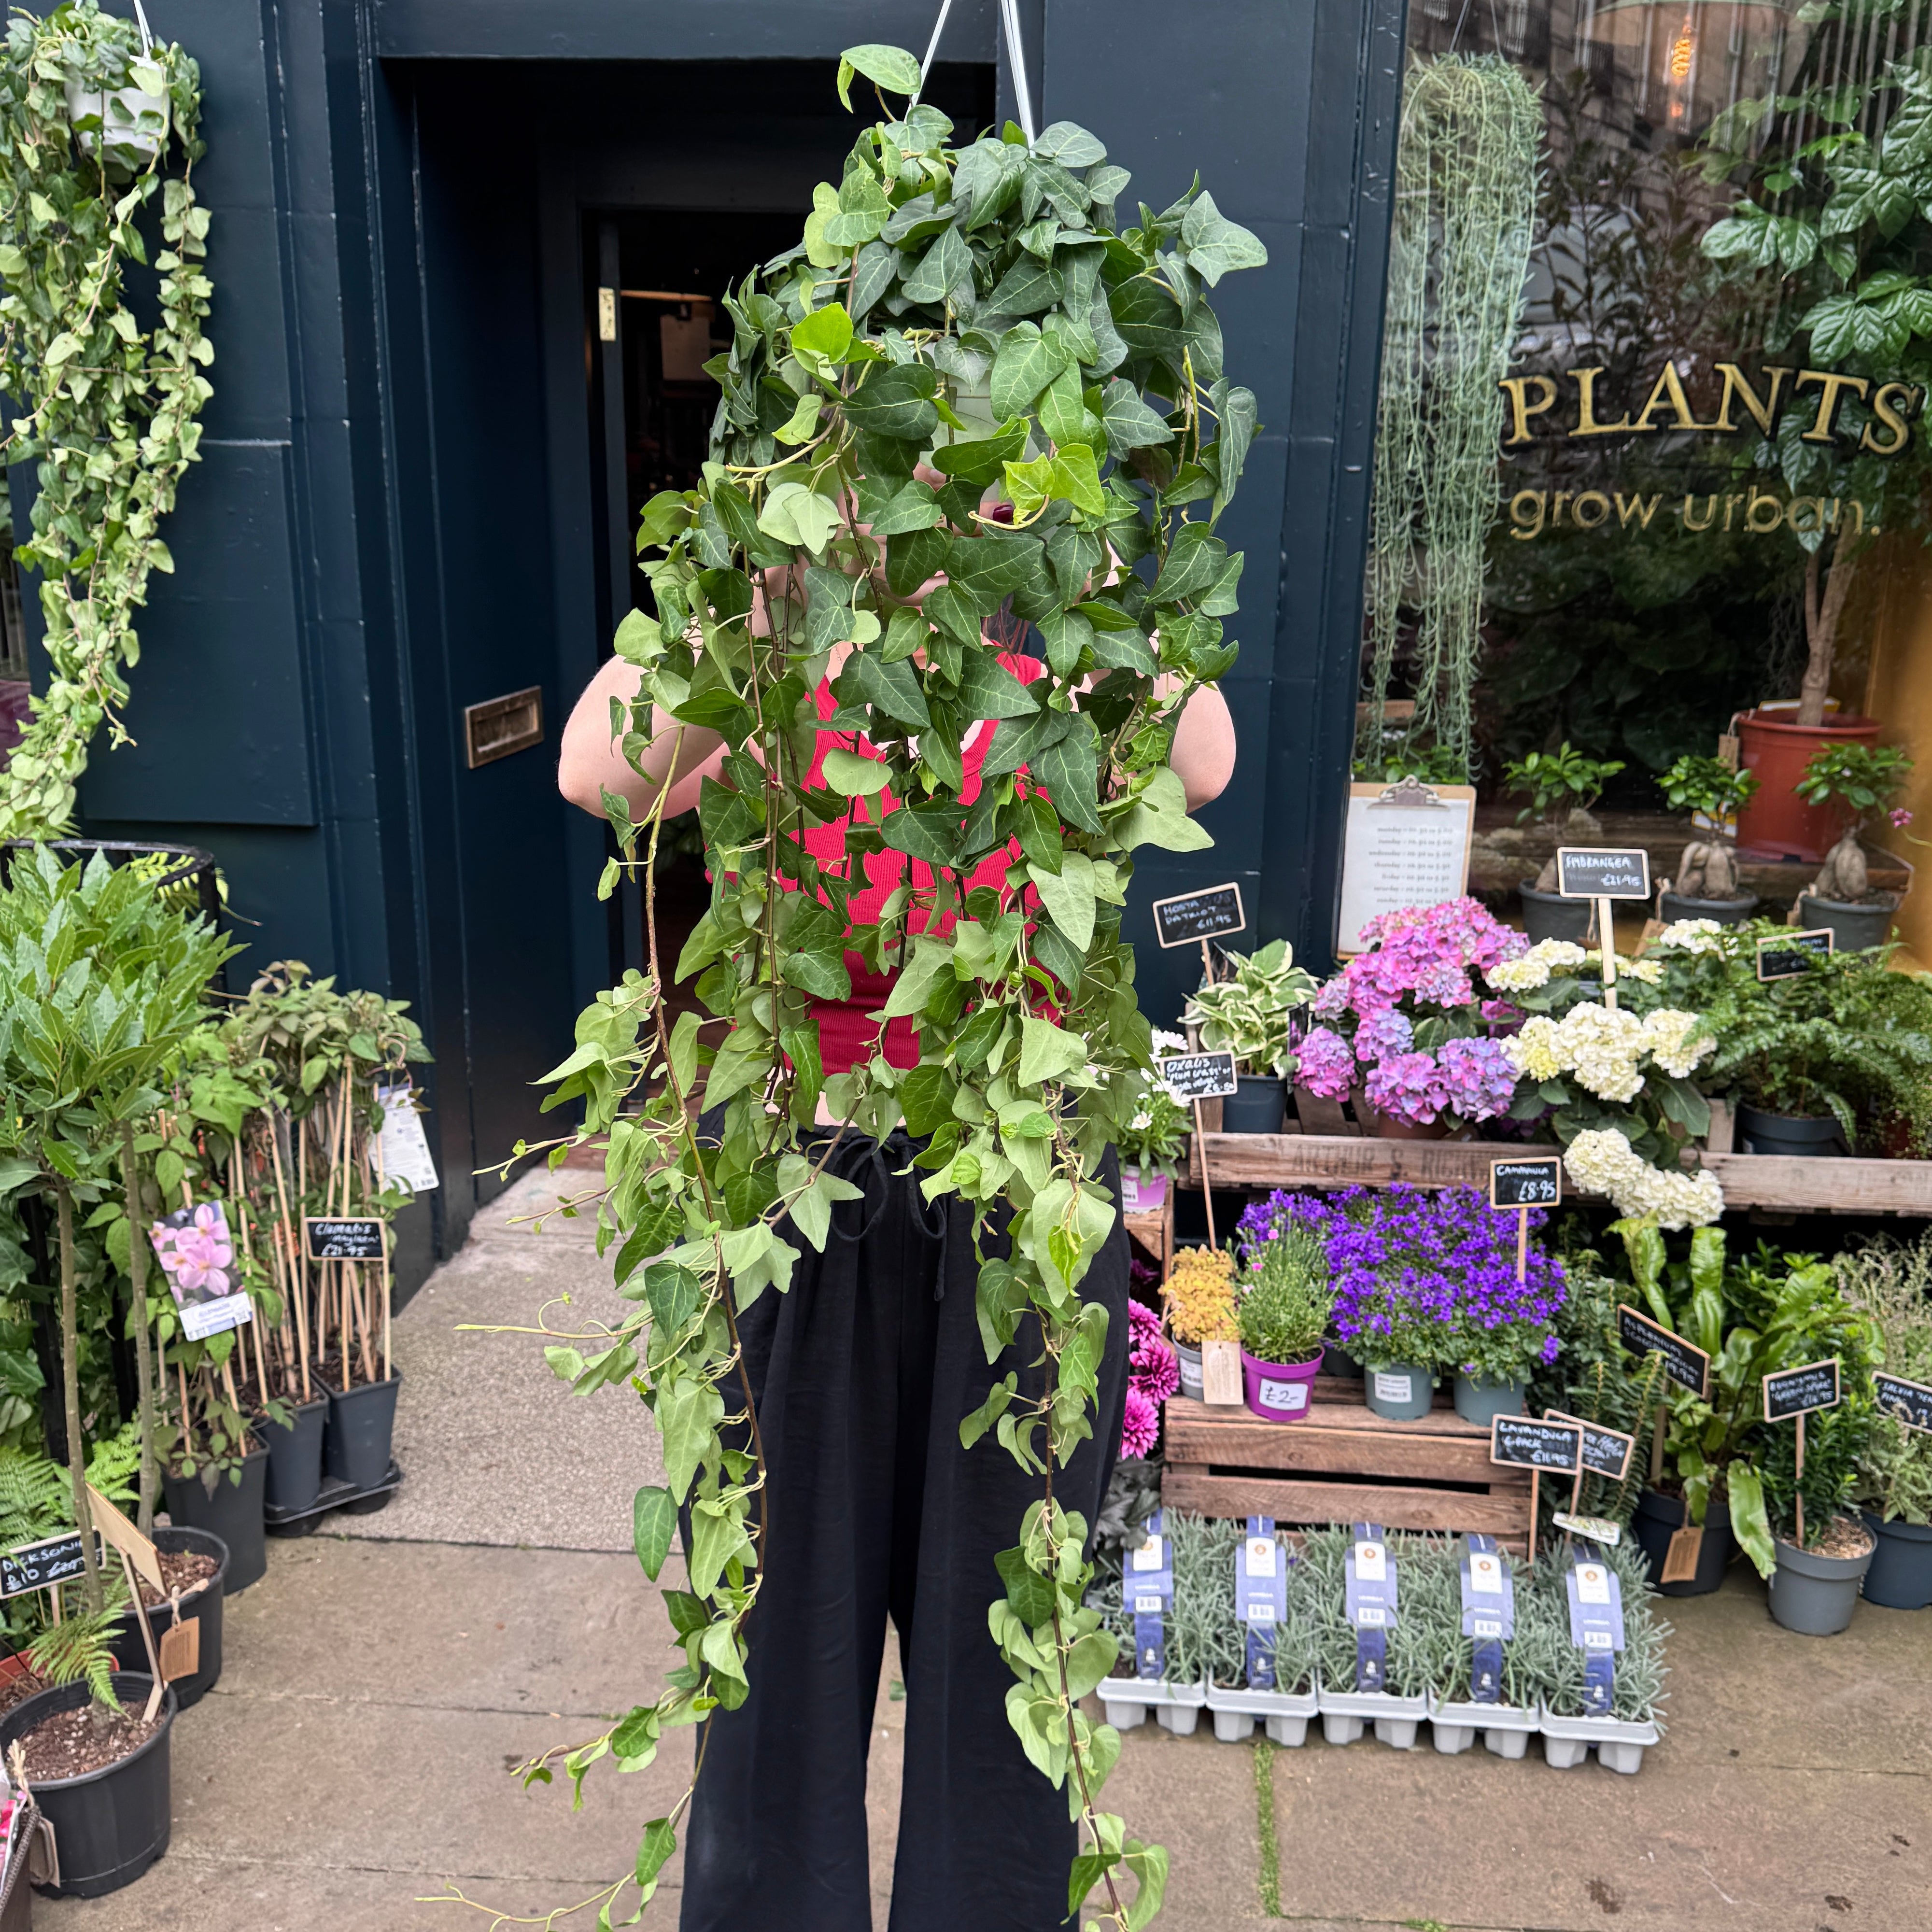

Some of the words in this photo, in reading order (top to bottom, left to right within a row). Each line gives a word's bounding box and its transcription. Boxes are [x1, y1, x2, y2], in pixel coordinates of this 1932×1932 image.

[1499, 360, 1919, 455] PLANTS
[1509, 488, 1664, 540] grow
[1683, 485, 1881, 537] urban.
[1163, 900, 1199, 916] HOSTA
[1518, 1180, 1556, 1202] £8.95
[321, 1243, 368, 1257] £21.95
[1499, 1422, 1572, 1442] LAVANDULA
